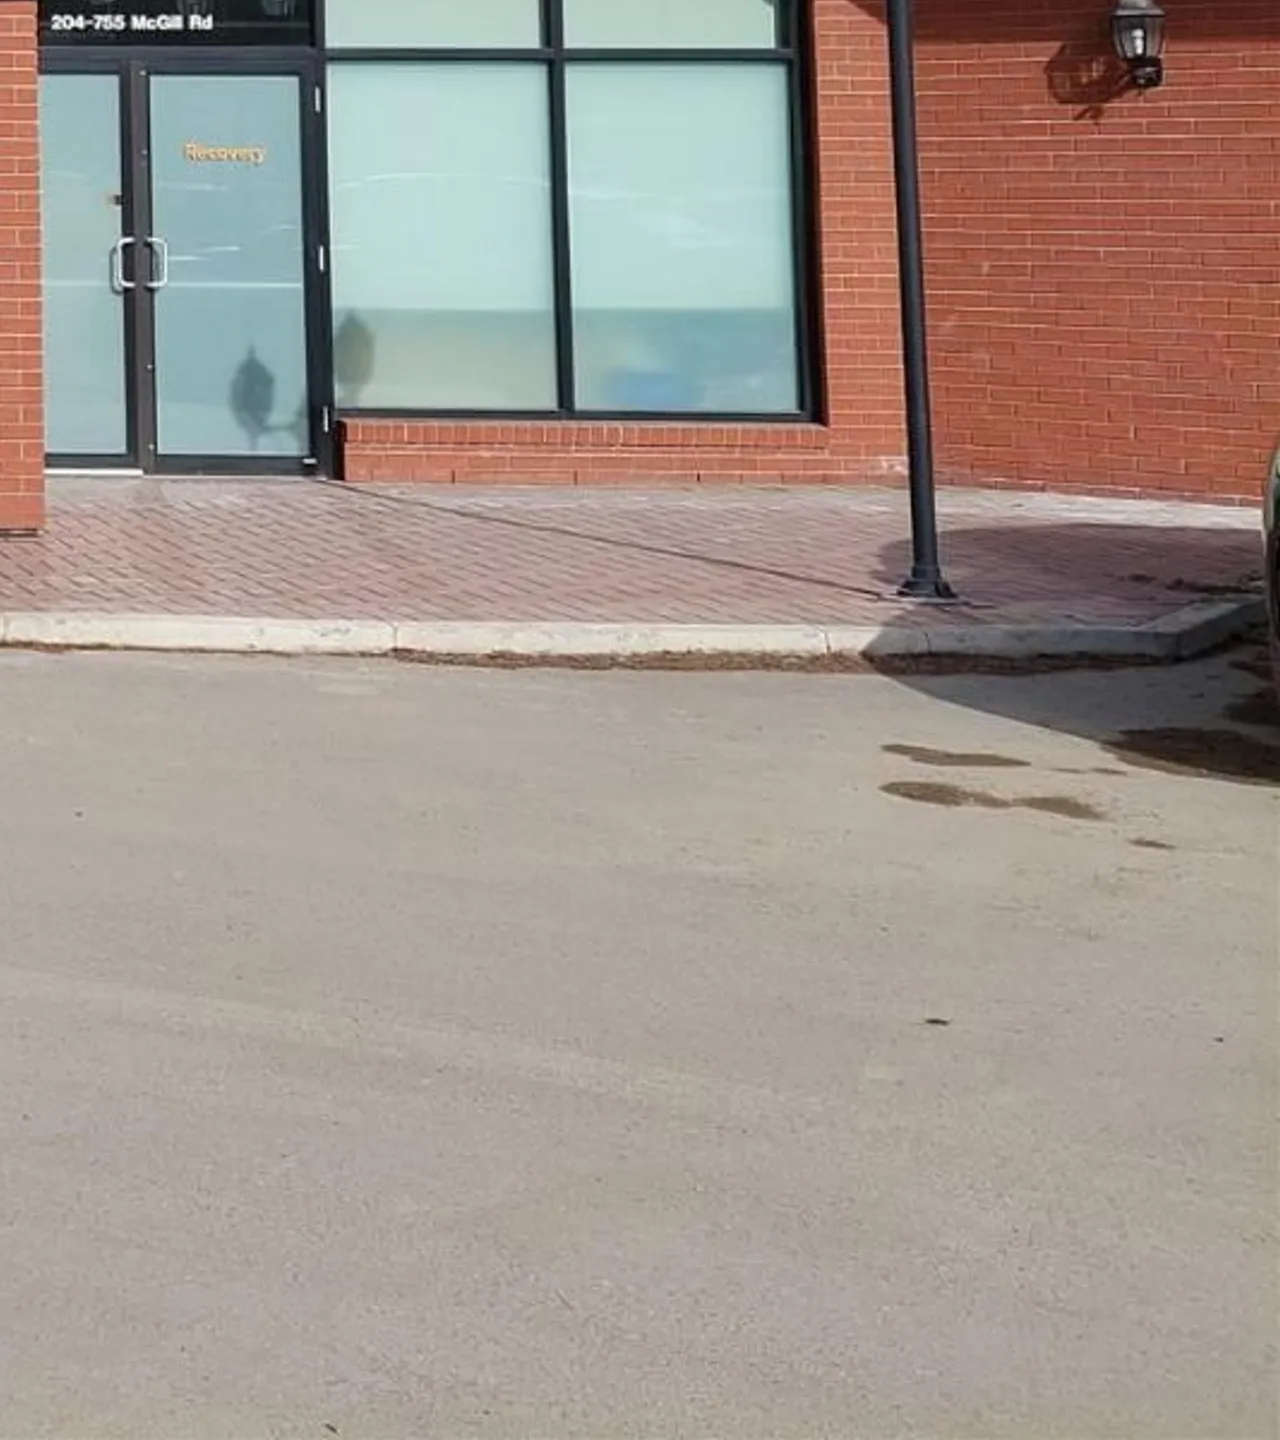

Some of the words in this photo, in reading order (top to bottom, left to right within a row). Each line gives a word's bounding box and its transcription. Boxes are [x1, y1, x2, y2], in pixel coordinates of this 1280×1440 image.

[51, 14, 127, 30] 204-755
[131, 14, 184, 30] McGill
[189, 14, 213, 30] Rd
[184, 143, 265, 165] Recovery
